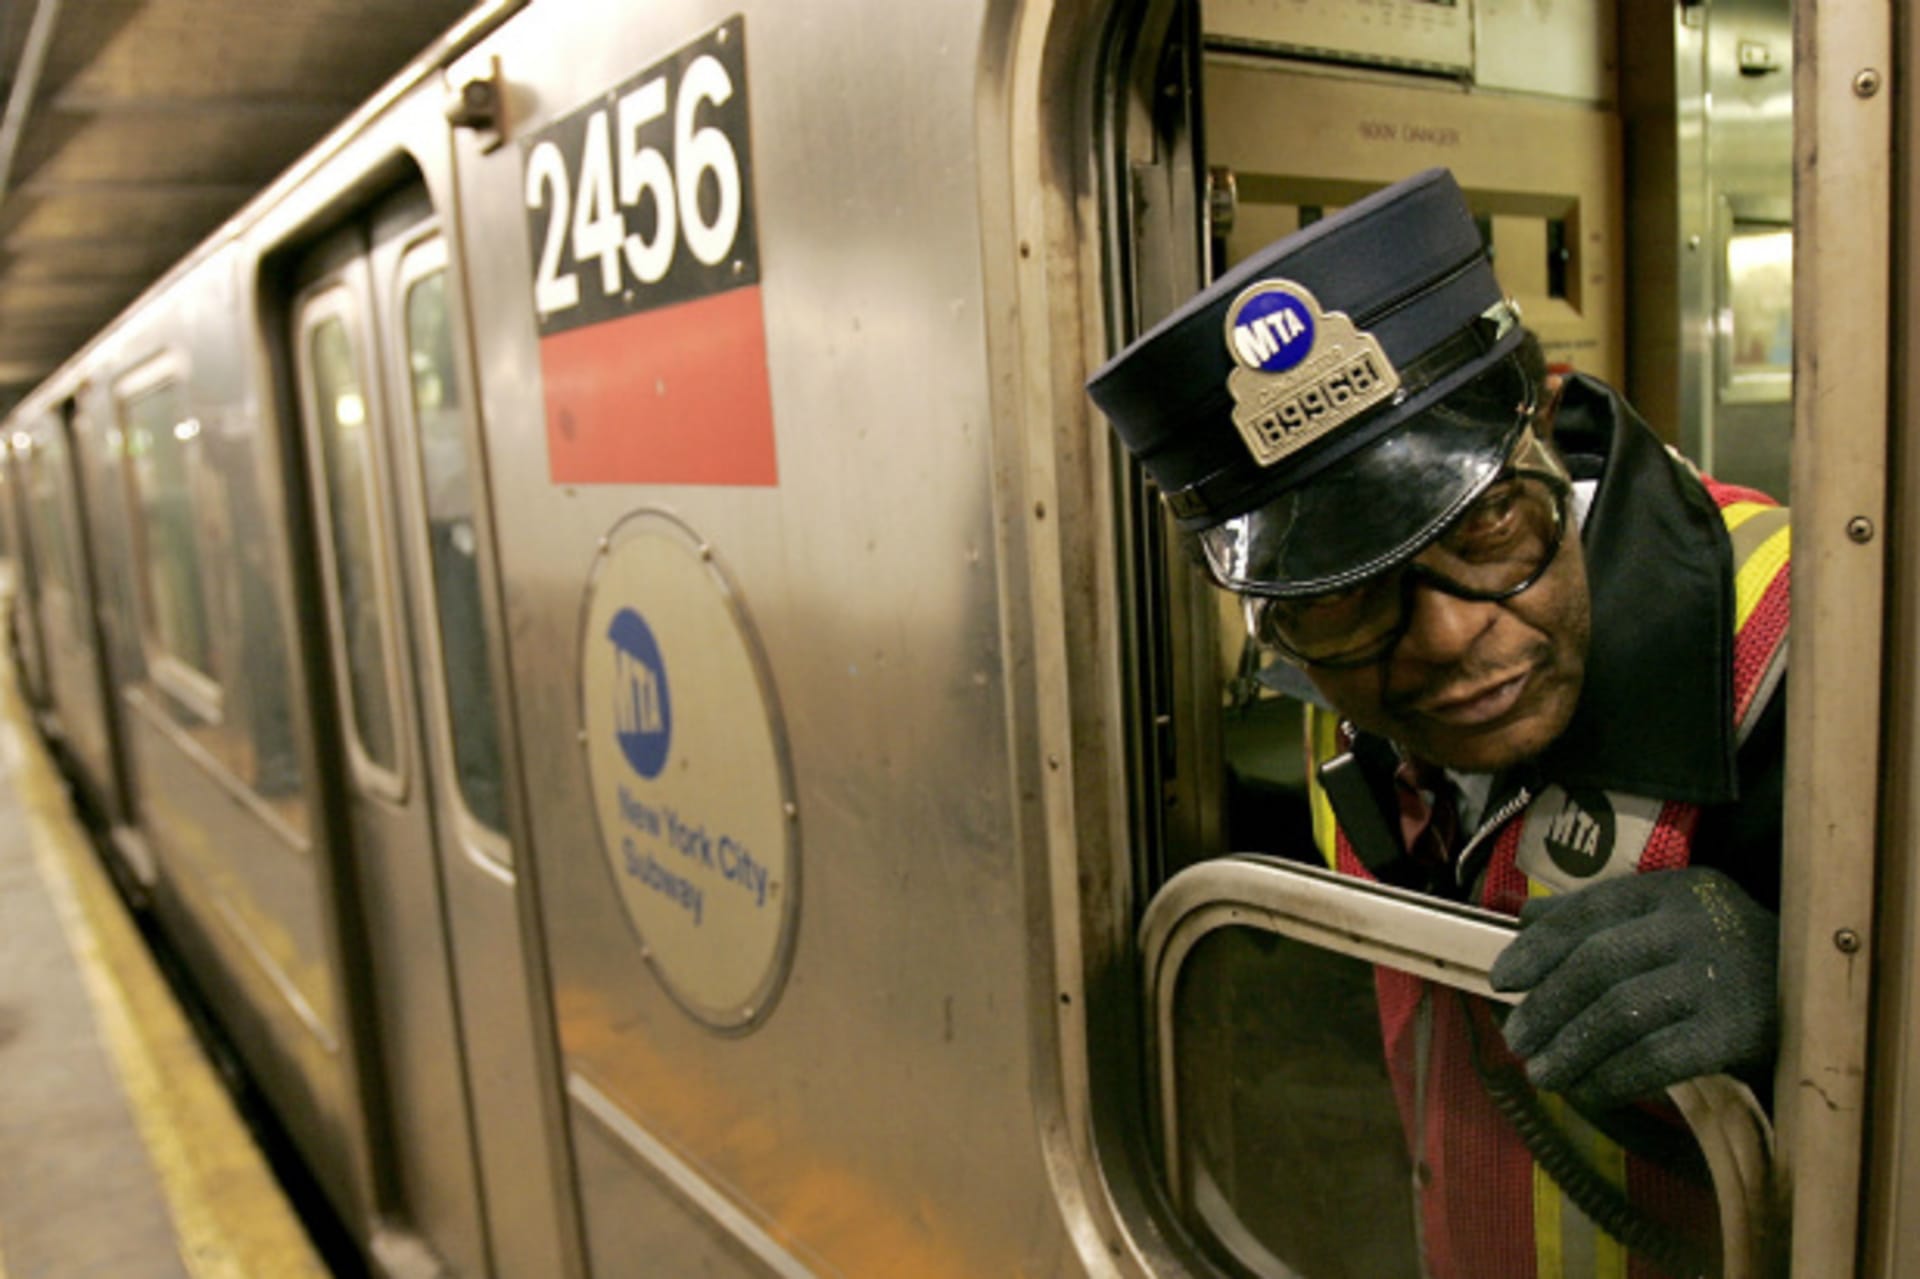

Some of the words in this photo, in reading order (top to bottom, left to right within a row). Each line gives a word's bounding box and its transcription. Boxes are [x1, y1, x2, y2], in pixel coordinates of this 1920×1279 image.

[525, 54, 741, 315] 2456
[1233, 306, 1306, 369] MTA
[1258, 361, 1377, 446] 89968
[611, 643, 665, 735] MTA
[616, 782, 661, 839] New
[661, 806, 716, 870] York
[718, 834, 768, 909] City
[1549, 800, 1601, 858] MTA
[621, 835, 705, 928] Subway
